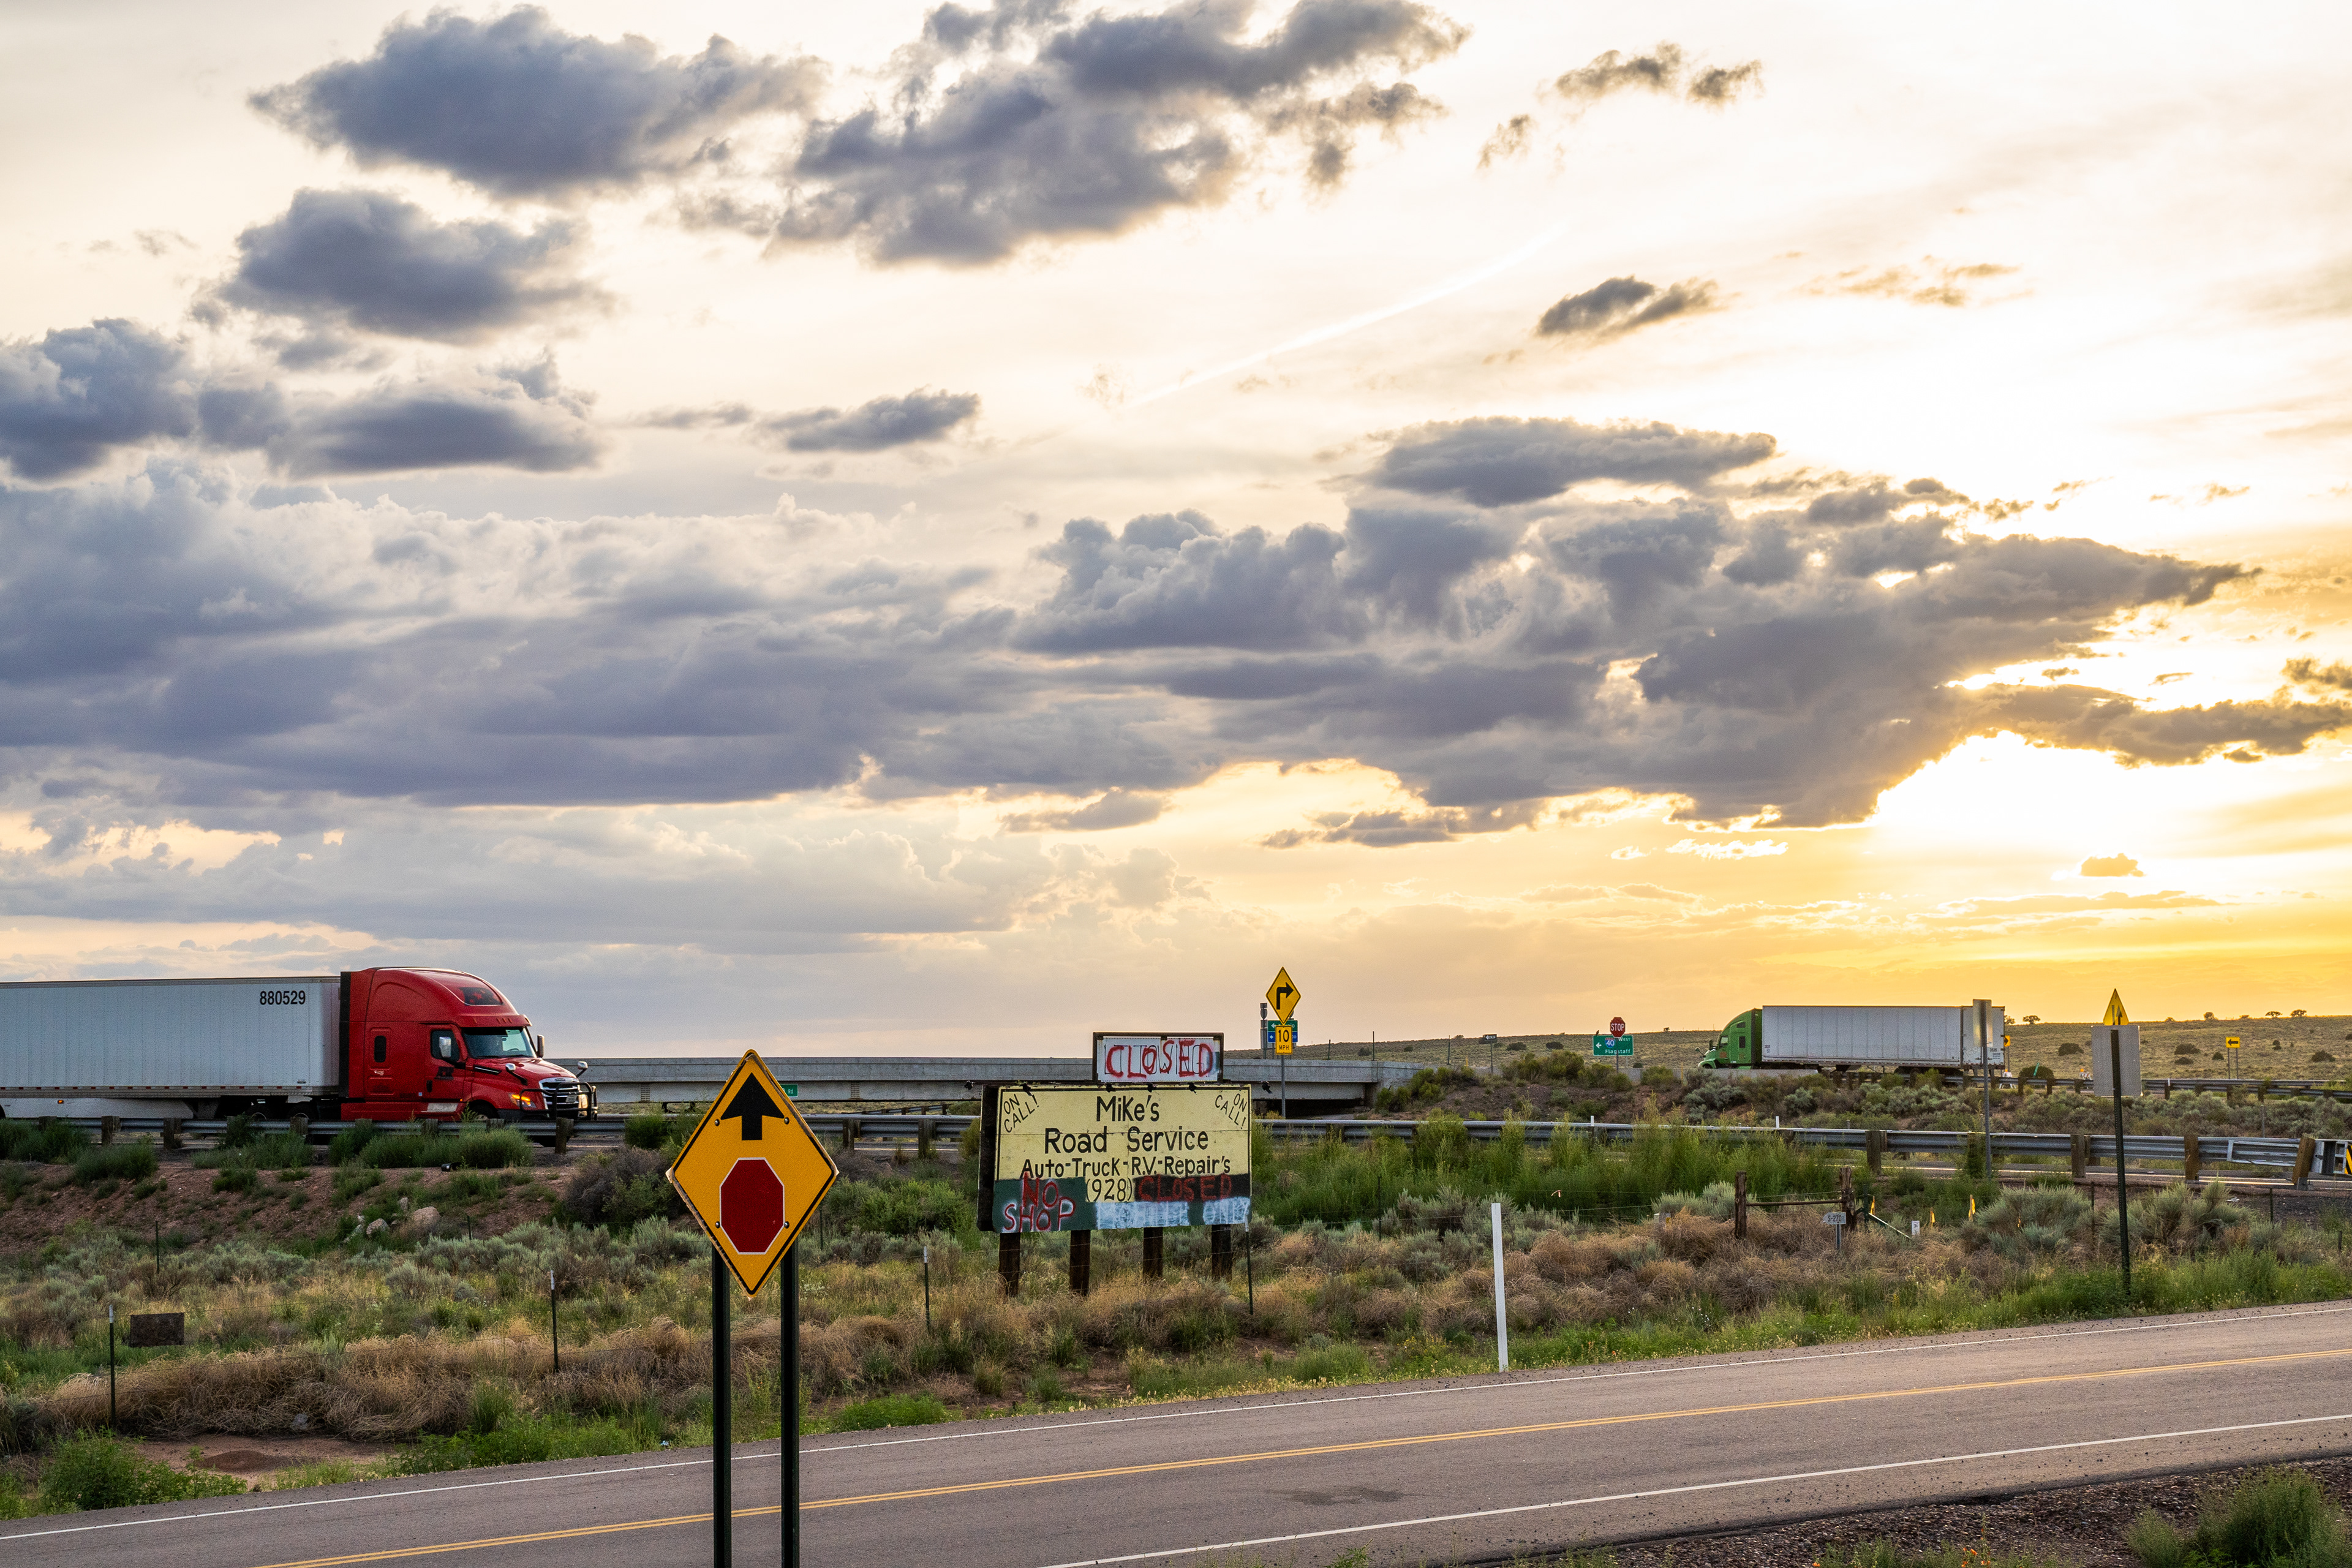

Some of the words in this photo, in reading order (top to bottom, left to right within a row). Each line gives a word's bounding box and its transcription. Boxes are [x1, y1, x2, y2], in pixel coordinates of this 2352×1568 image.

[259, 990, 306, 1005] 880529
[1278, 1030, 1289, 1042] 10
[1106, 1040, 1213, 1078] CLOSED
[1003, 1093, 1020, 1115] ON
[1004, 1095, 1039, 1133] CALL!
[1215, 1095, 1246, 1129] CALL!
[1234, 1093, 1247, 1112] ON
[1045, 1126, 1107, 1153] Road
[1127, 1126, 1208, 1152] Service
[1022, 1172, 1058, 1207] NO
[1087, 1177, 1132, 1202] (928)
[1138, 1174, 1232, 1202] CLOSED
[1004, 1196, 1076, 1232] SHOP
